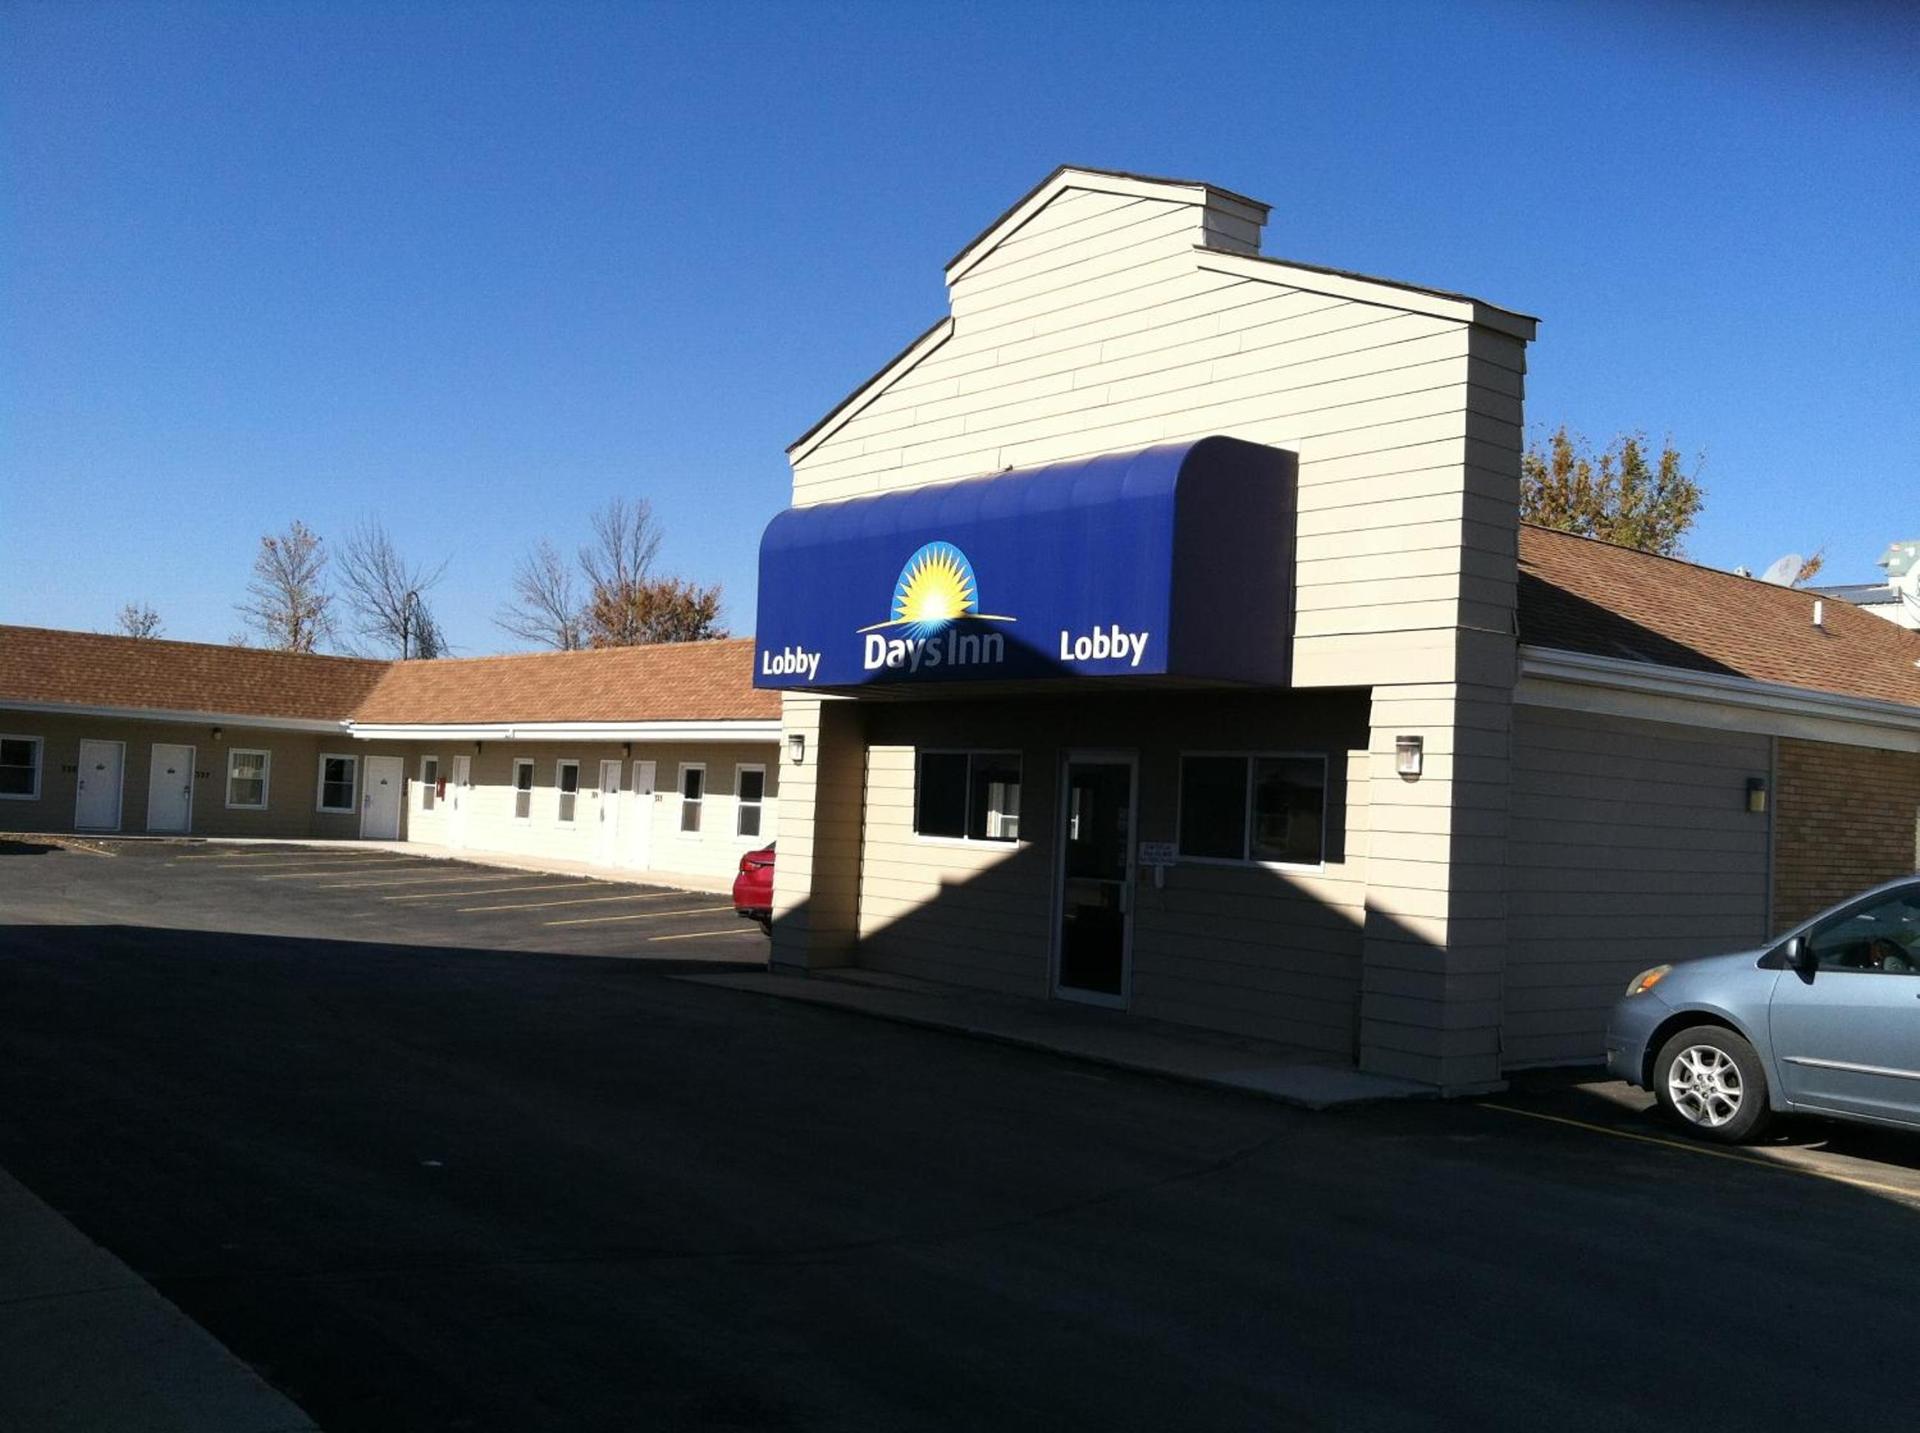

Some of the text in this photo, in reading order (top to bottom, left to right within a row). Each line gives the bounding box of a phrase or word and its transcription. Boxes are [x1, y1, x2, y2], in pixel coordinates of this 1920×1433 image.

[762, 646, 821, 681] Lobby
[864, 629, 1004, 673] Days Inn
[1060, 624, 1149, 667] Lobby
